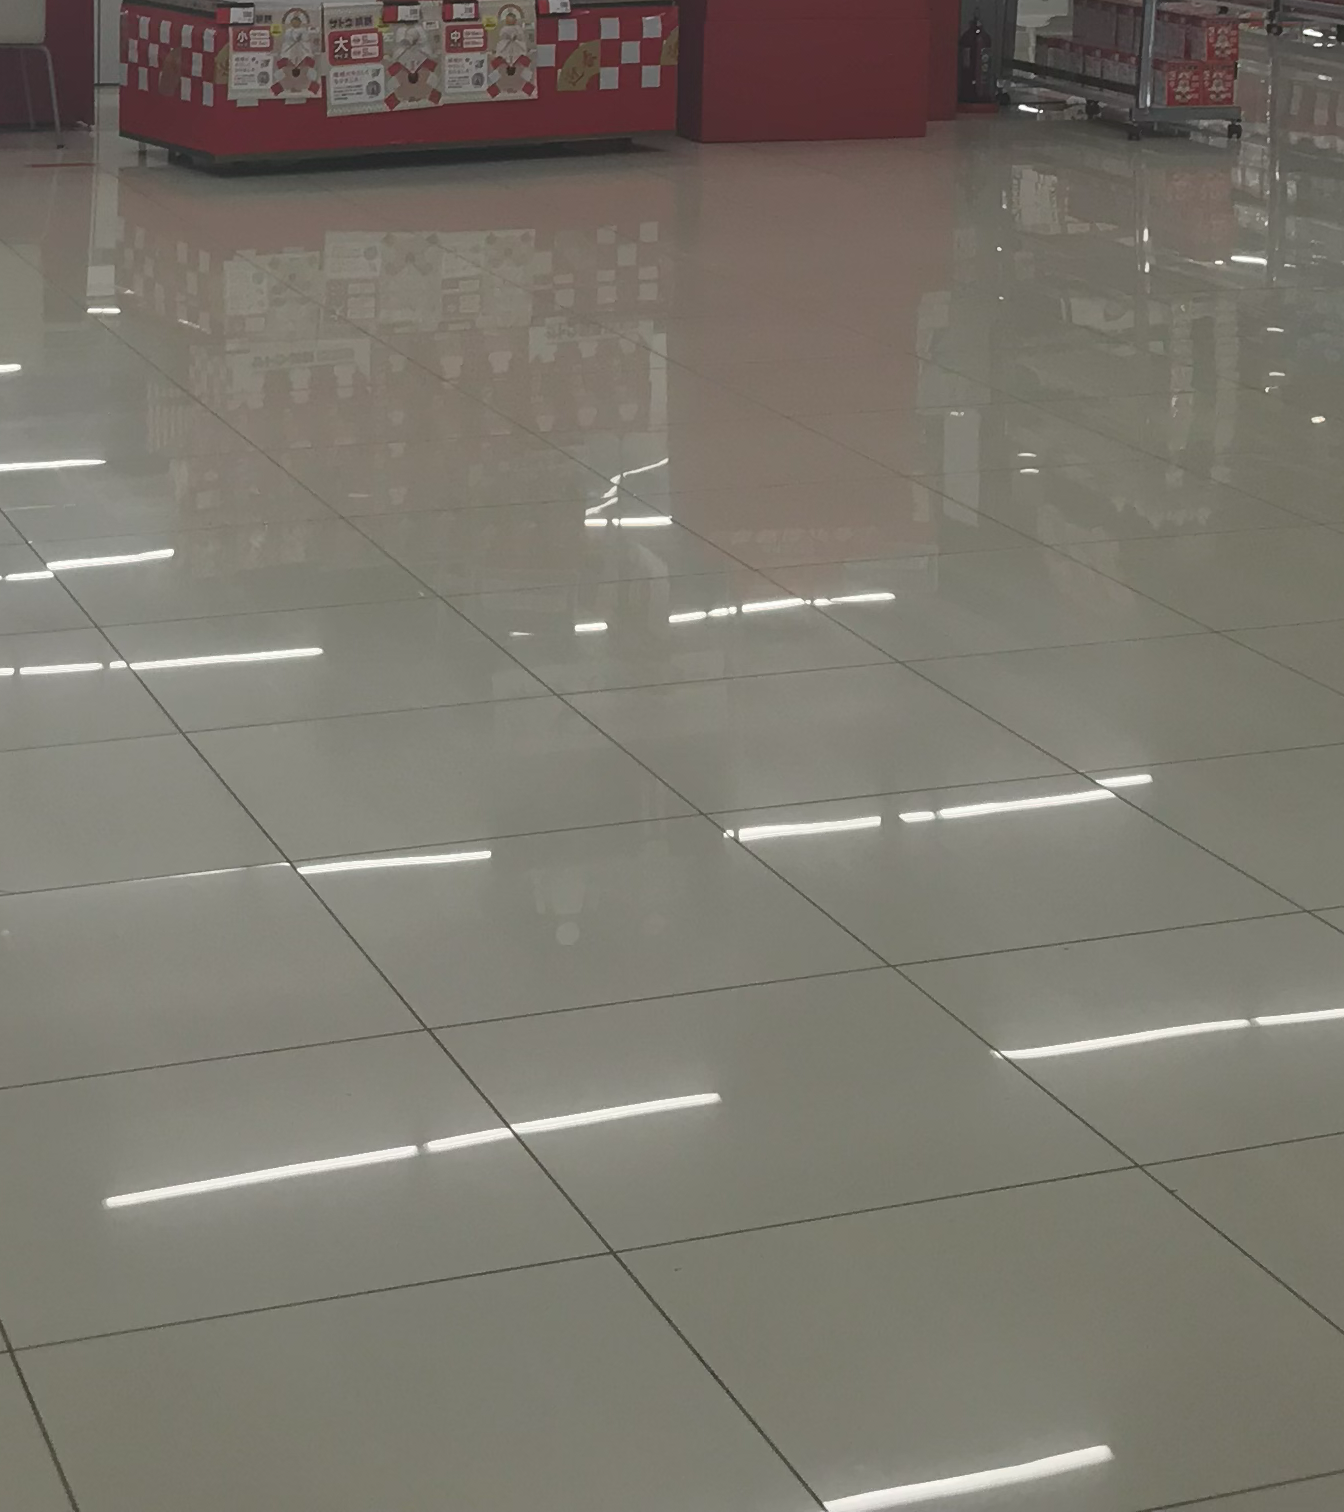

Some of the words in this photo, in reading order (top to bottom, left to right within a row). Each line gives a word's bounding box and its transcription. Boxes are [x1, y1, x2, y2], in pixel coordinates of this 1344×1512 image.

[237, 30, 248, 43] 小
[450, 30, 461, 43] 中
[334, 36, 349, 53] 大
